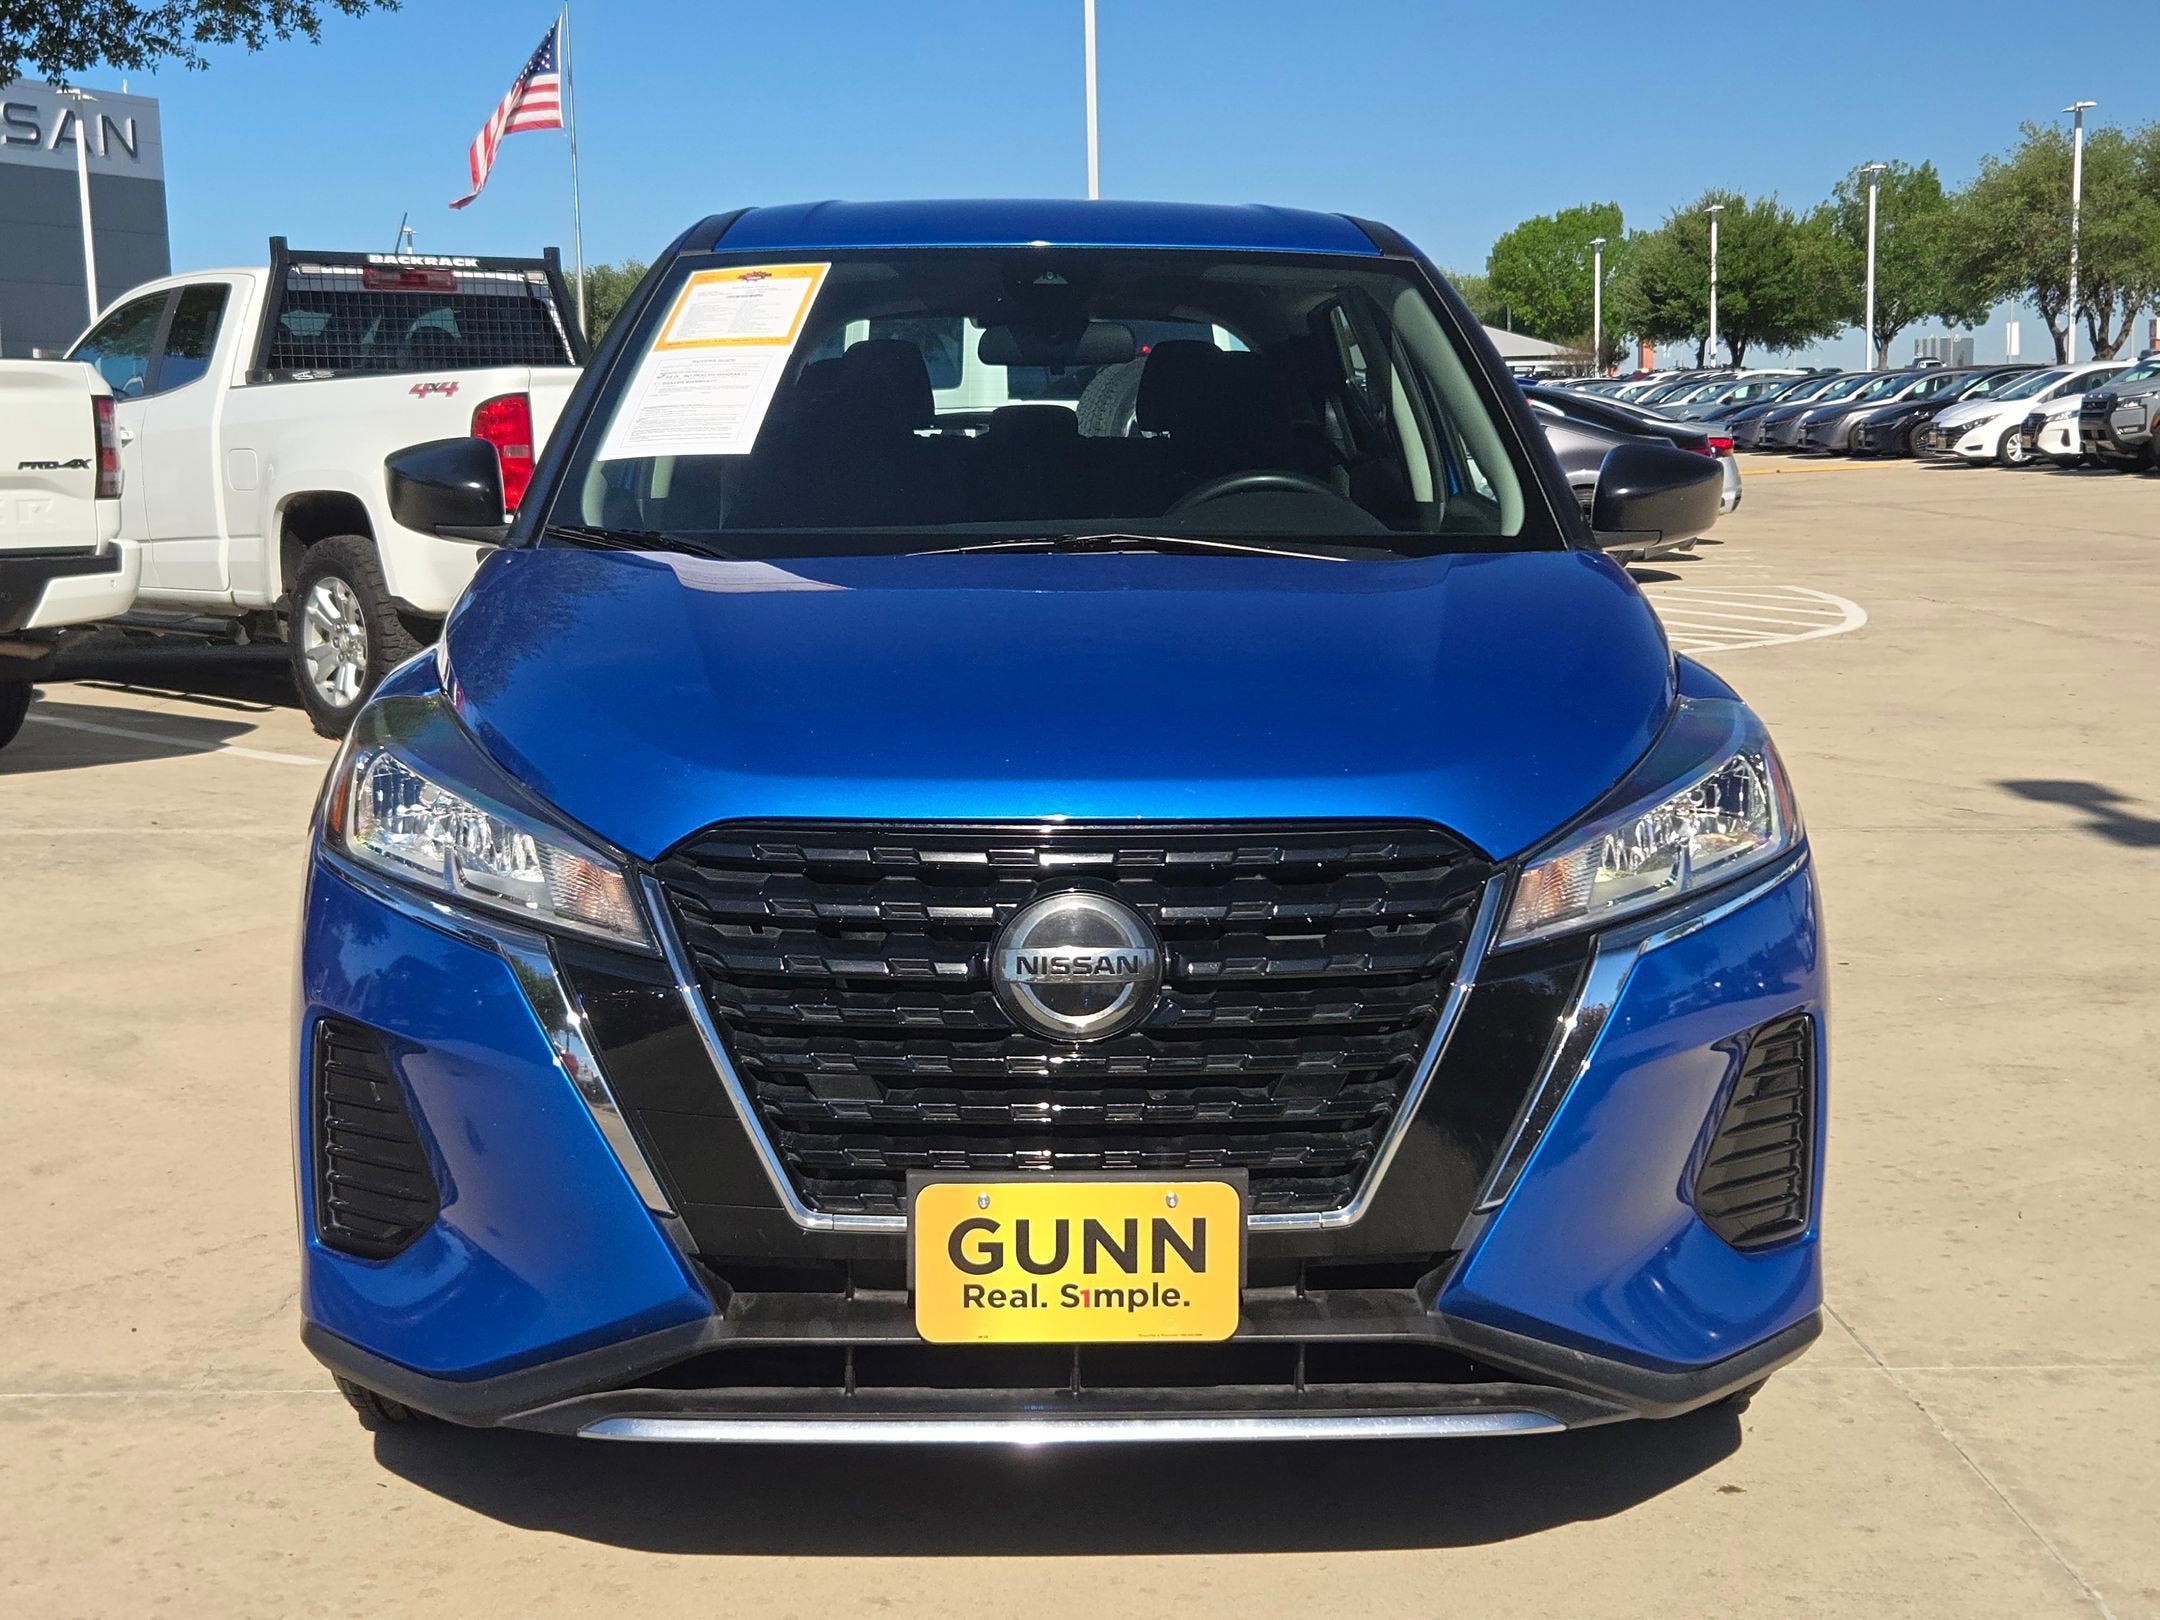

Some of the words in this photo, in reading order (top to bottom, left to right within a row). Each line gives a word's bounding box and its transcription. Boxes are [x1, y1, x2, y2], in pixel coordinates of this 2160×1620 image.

[368, 254, 480, 268] BACKRACK
[1016, 955, 1139, 975] NISSAN
[947, 1217, 1207, 1276] GUNN
[963, 1283, 1048, 1309] Real.
